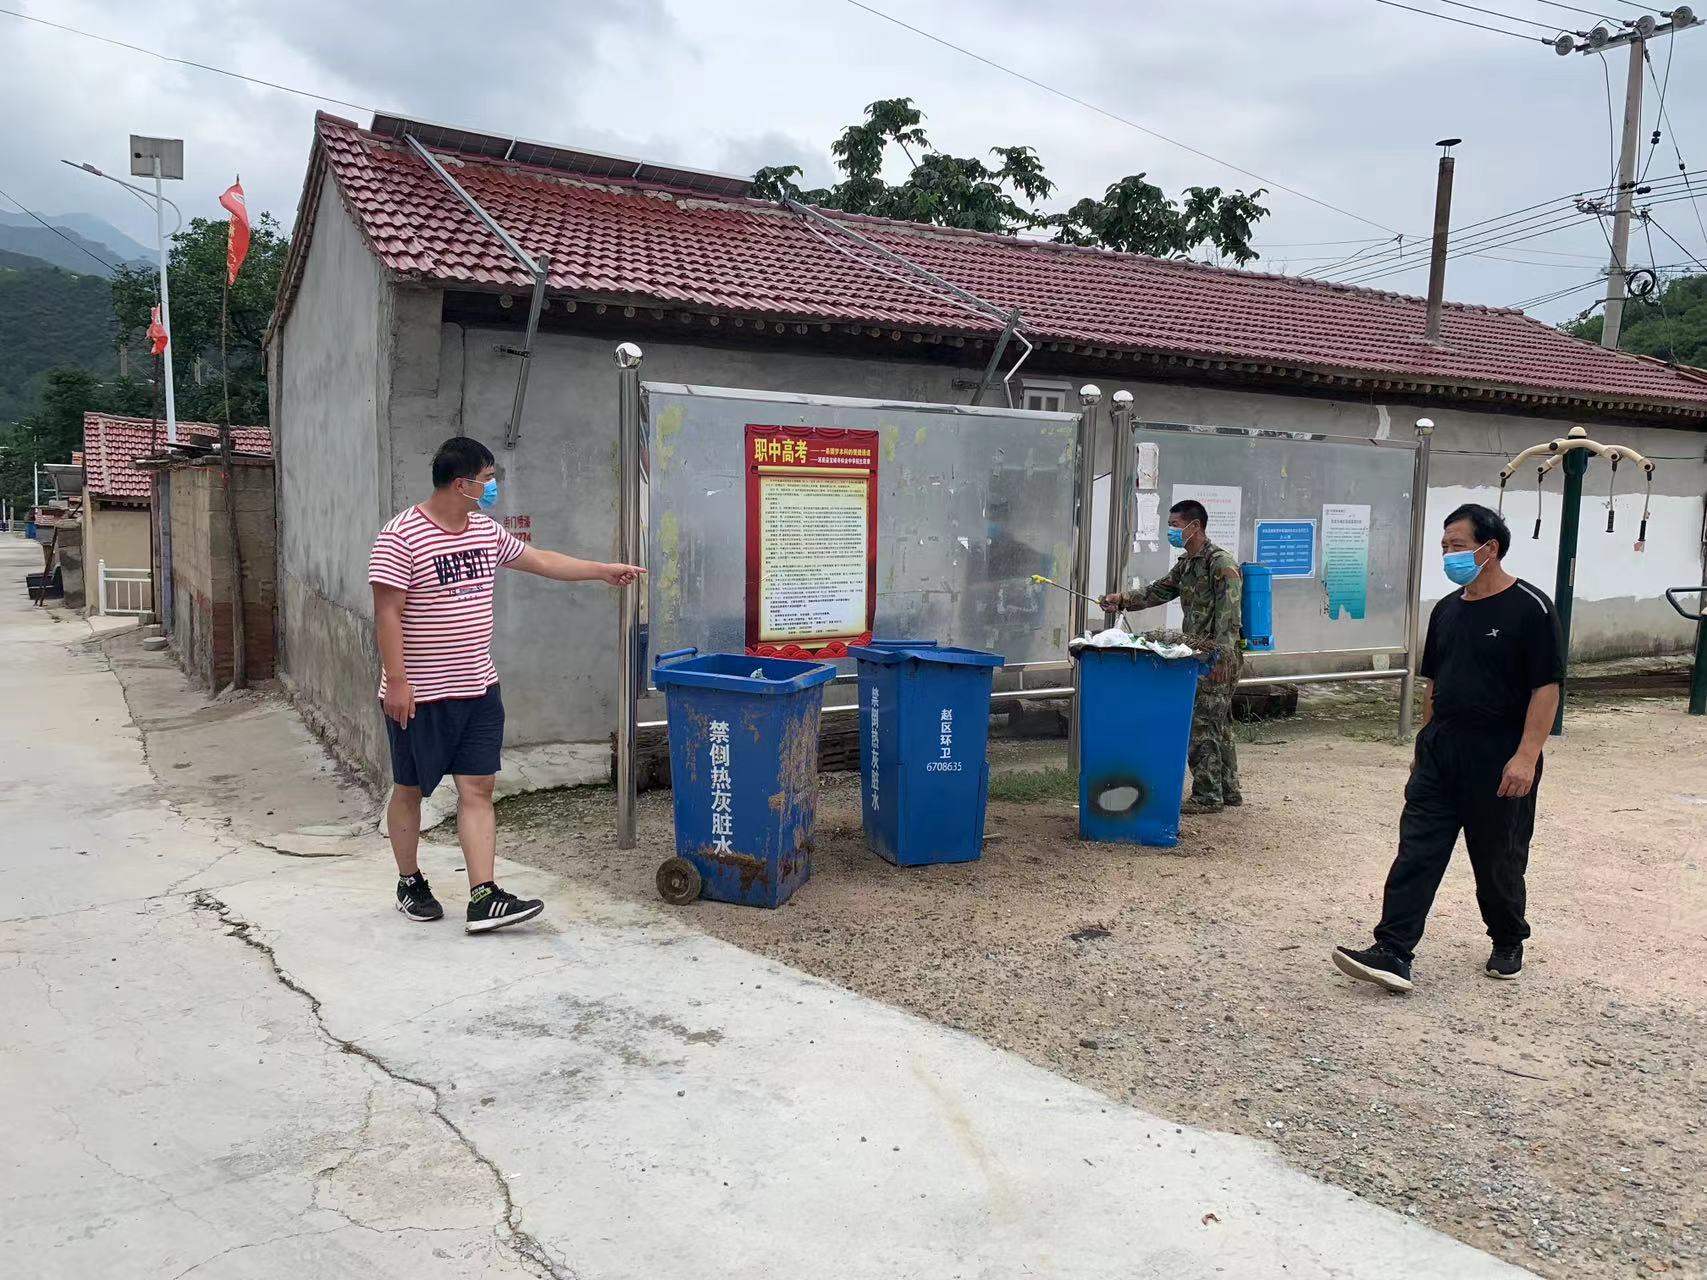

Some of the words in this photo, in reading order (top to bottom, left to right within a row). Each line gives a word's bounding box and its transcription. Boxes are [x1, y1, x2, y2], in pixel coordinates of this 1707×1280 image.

[754, 438, 808, 464] 职中高考
[870, 687, 881, 812] 禁倒热灰脏水
[939, 709, 953, 759] 赵区环卫
[709, 720, 733, 856] 禁倒热灰脏水
[926, 761, 963, 773] 6708635
